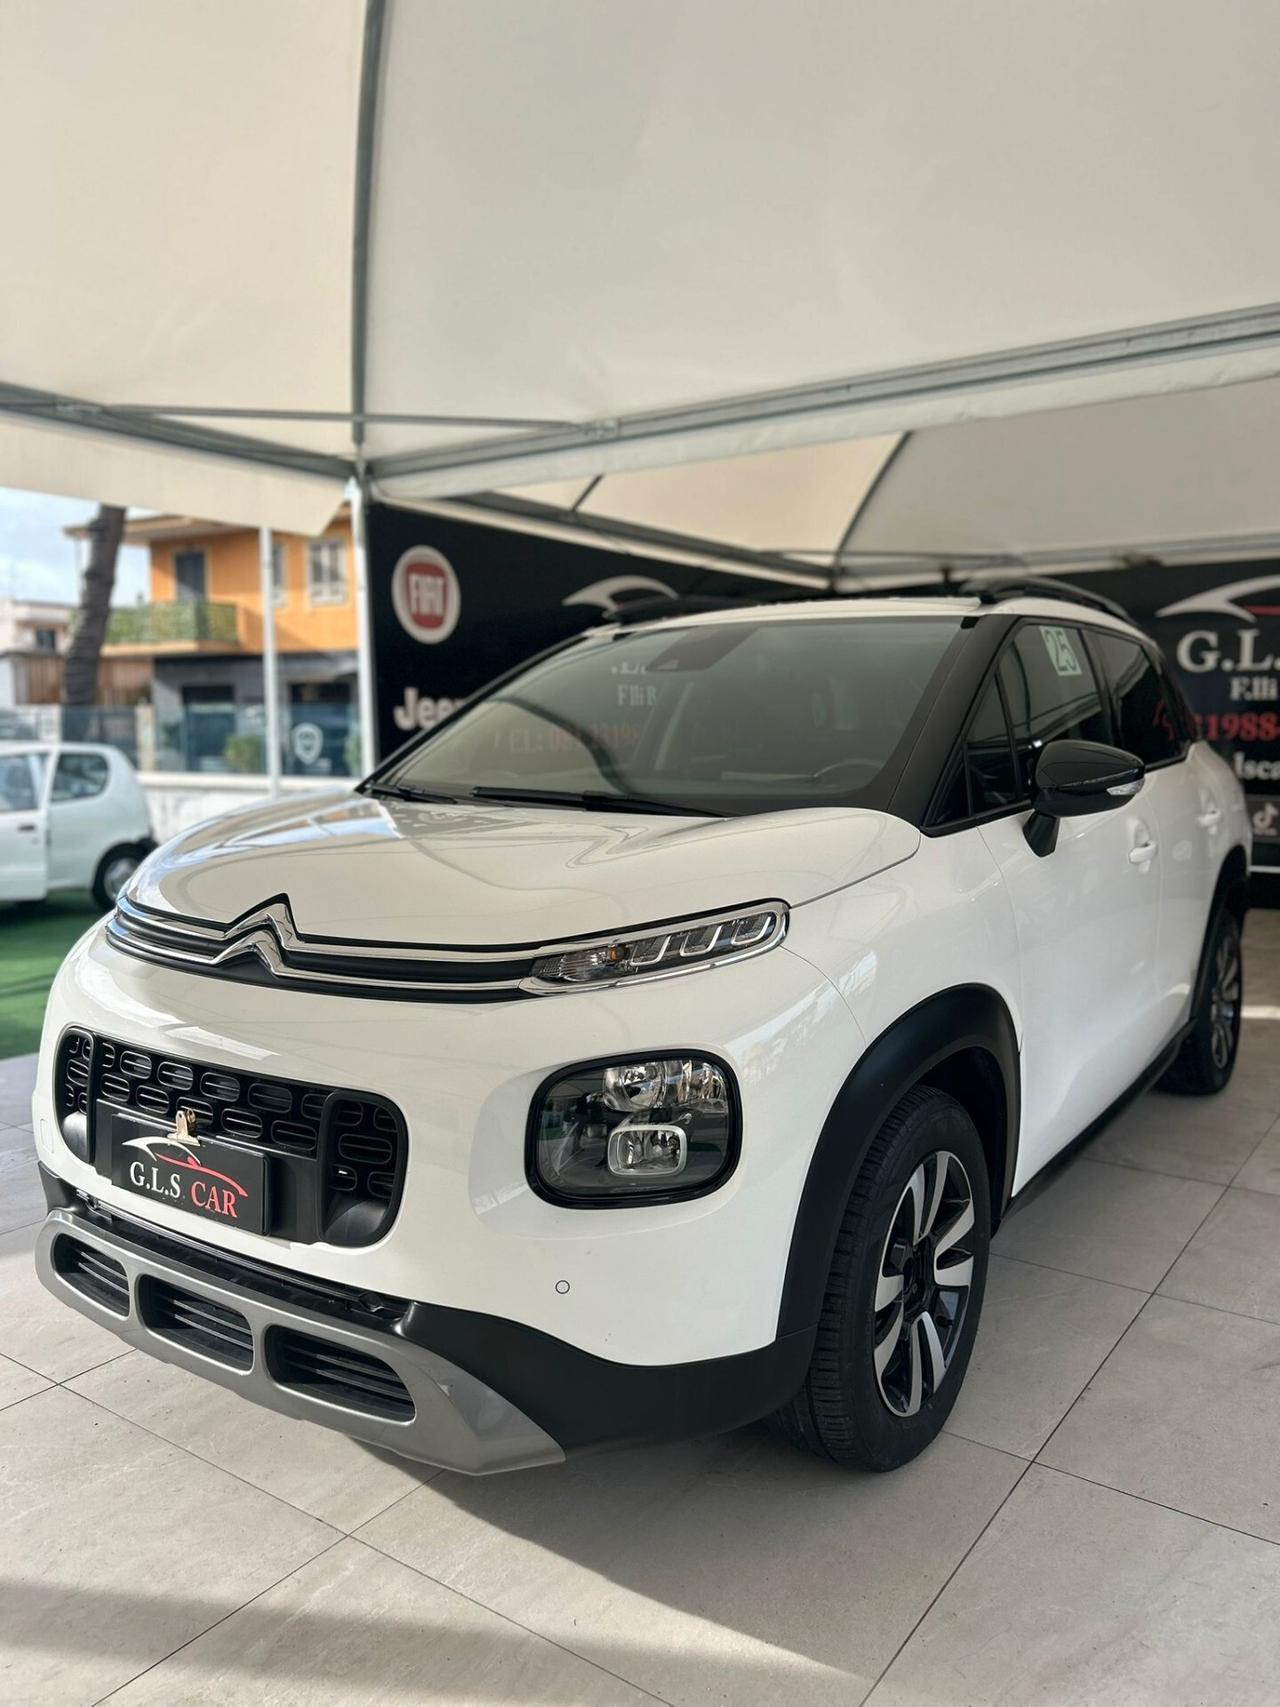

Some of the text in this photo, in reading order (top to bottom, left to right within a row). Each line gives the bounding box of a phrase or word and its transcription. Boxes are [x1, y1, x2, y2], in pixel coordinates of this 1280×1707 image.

[408, 572, 446, 617] FIAT
[393, 687, 465, 731] Jee
[130, 1161, 238, 1218] G.L.S CAR
